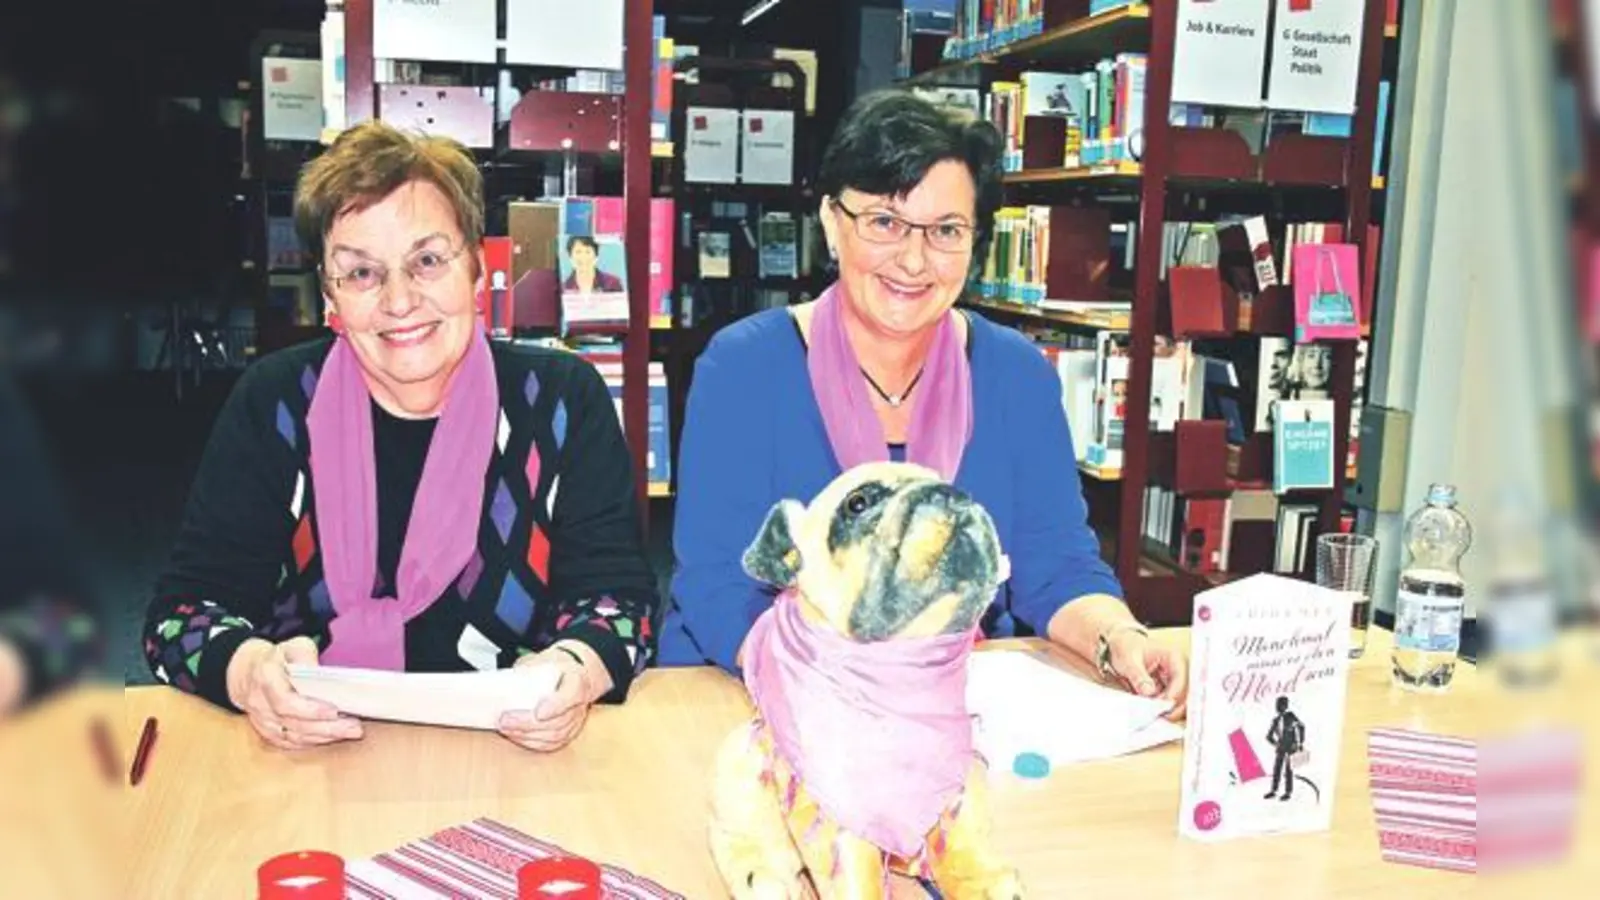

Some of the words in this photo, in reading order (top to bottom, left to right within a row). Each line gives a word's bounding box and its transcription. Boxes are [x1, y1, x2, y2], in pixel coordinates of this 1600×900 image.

[1186, 20, 1203, 32] Job
[1206, 22, 1213, 33] &
[1216, 24, 1254, 37] Karriere
[1293, 29, 1351, 45] Gesellschaft
[1292, 46, 1317, 59] Staat
[1291, 62, 1322, 75] Politik
[1232, 620, 1337, 657] Manchmal
[1222, 664, 1306, 703] Mord
